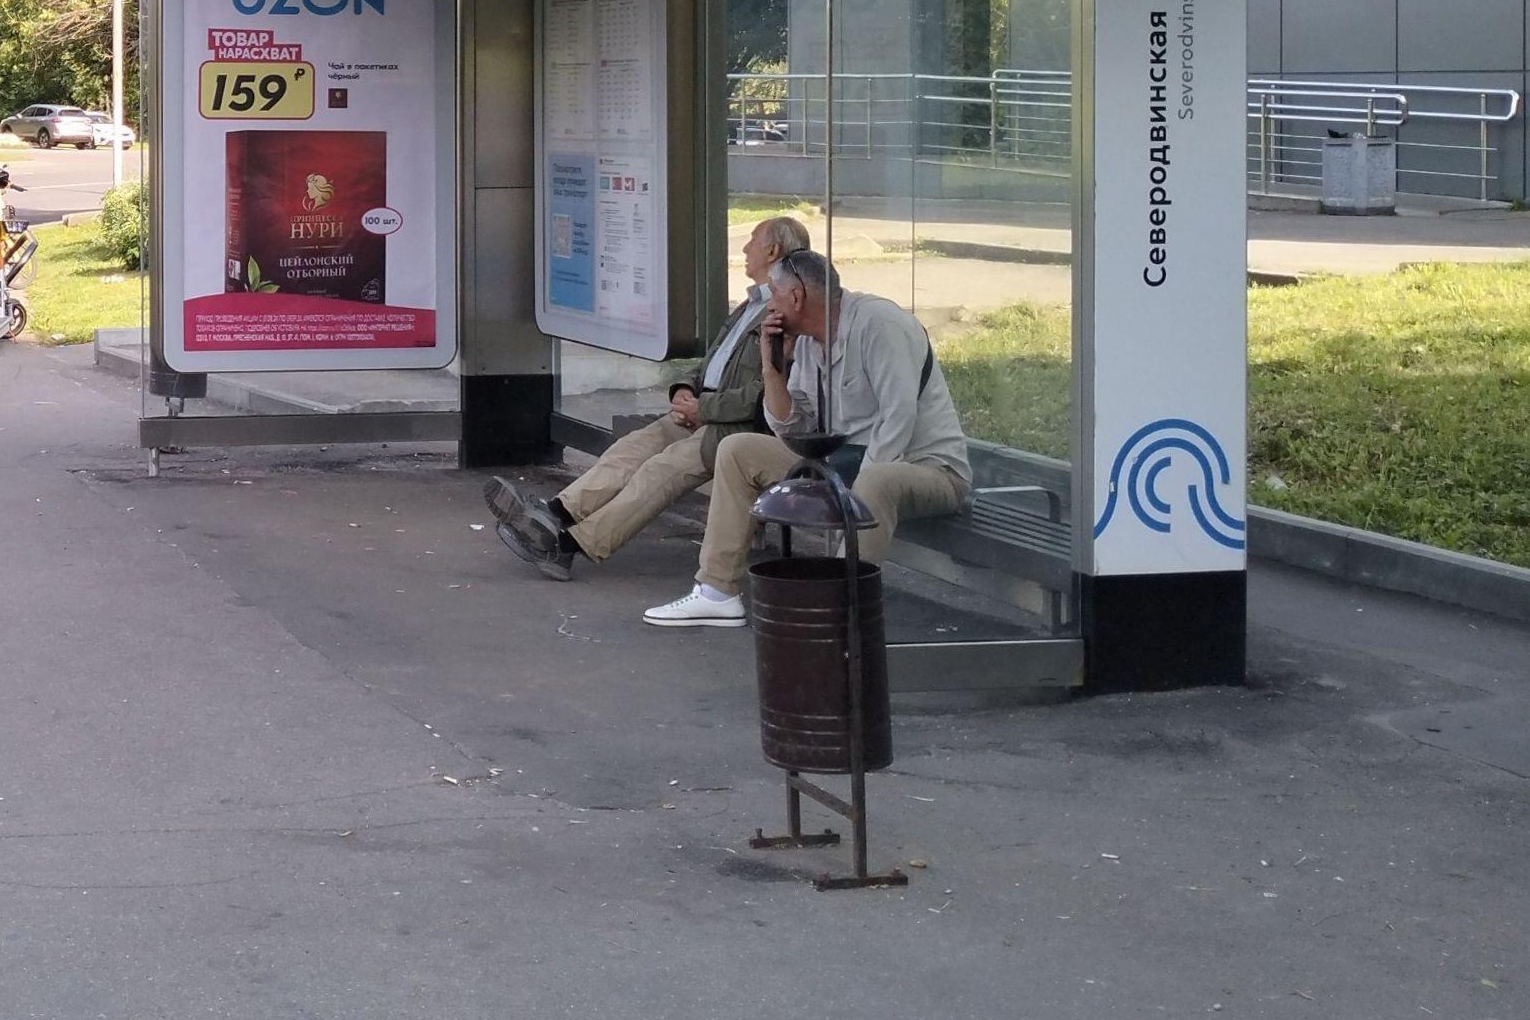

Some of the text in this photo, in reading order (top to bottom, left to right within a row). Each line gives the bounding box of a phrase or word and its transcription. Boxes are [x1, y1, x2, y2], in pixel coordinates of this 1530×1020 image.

[212, 31, 269, 47] ТОВАР
[218, 47, 299, 60] НАРАСХВАТ
[328, 61, 345, 71] Чай
[354, 63, 399, 71] пакетиках
[212, 74, 287, 112] 159
[1143, 10, 1172, 288] Северодвинская
[364, 216, 380, 225] 100
[289, 221, 344, 239] НУРИ
[279, 254, 354, 268] ЦЕЙЛОНСКИЙ
[286, 266, 346, 279] ОТБОРНЫЙ
